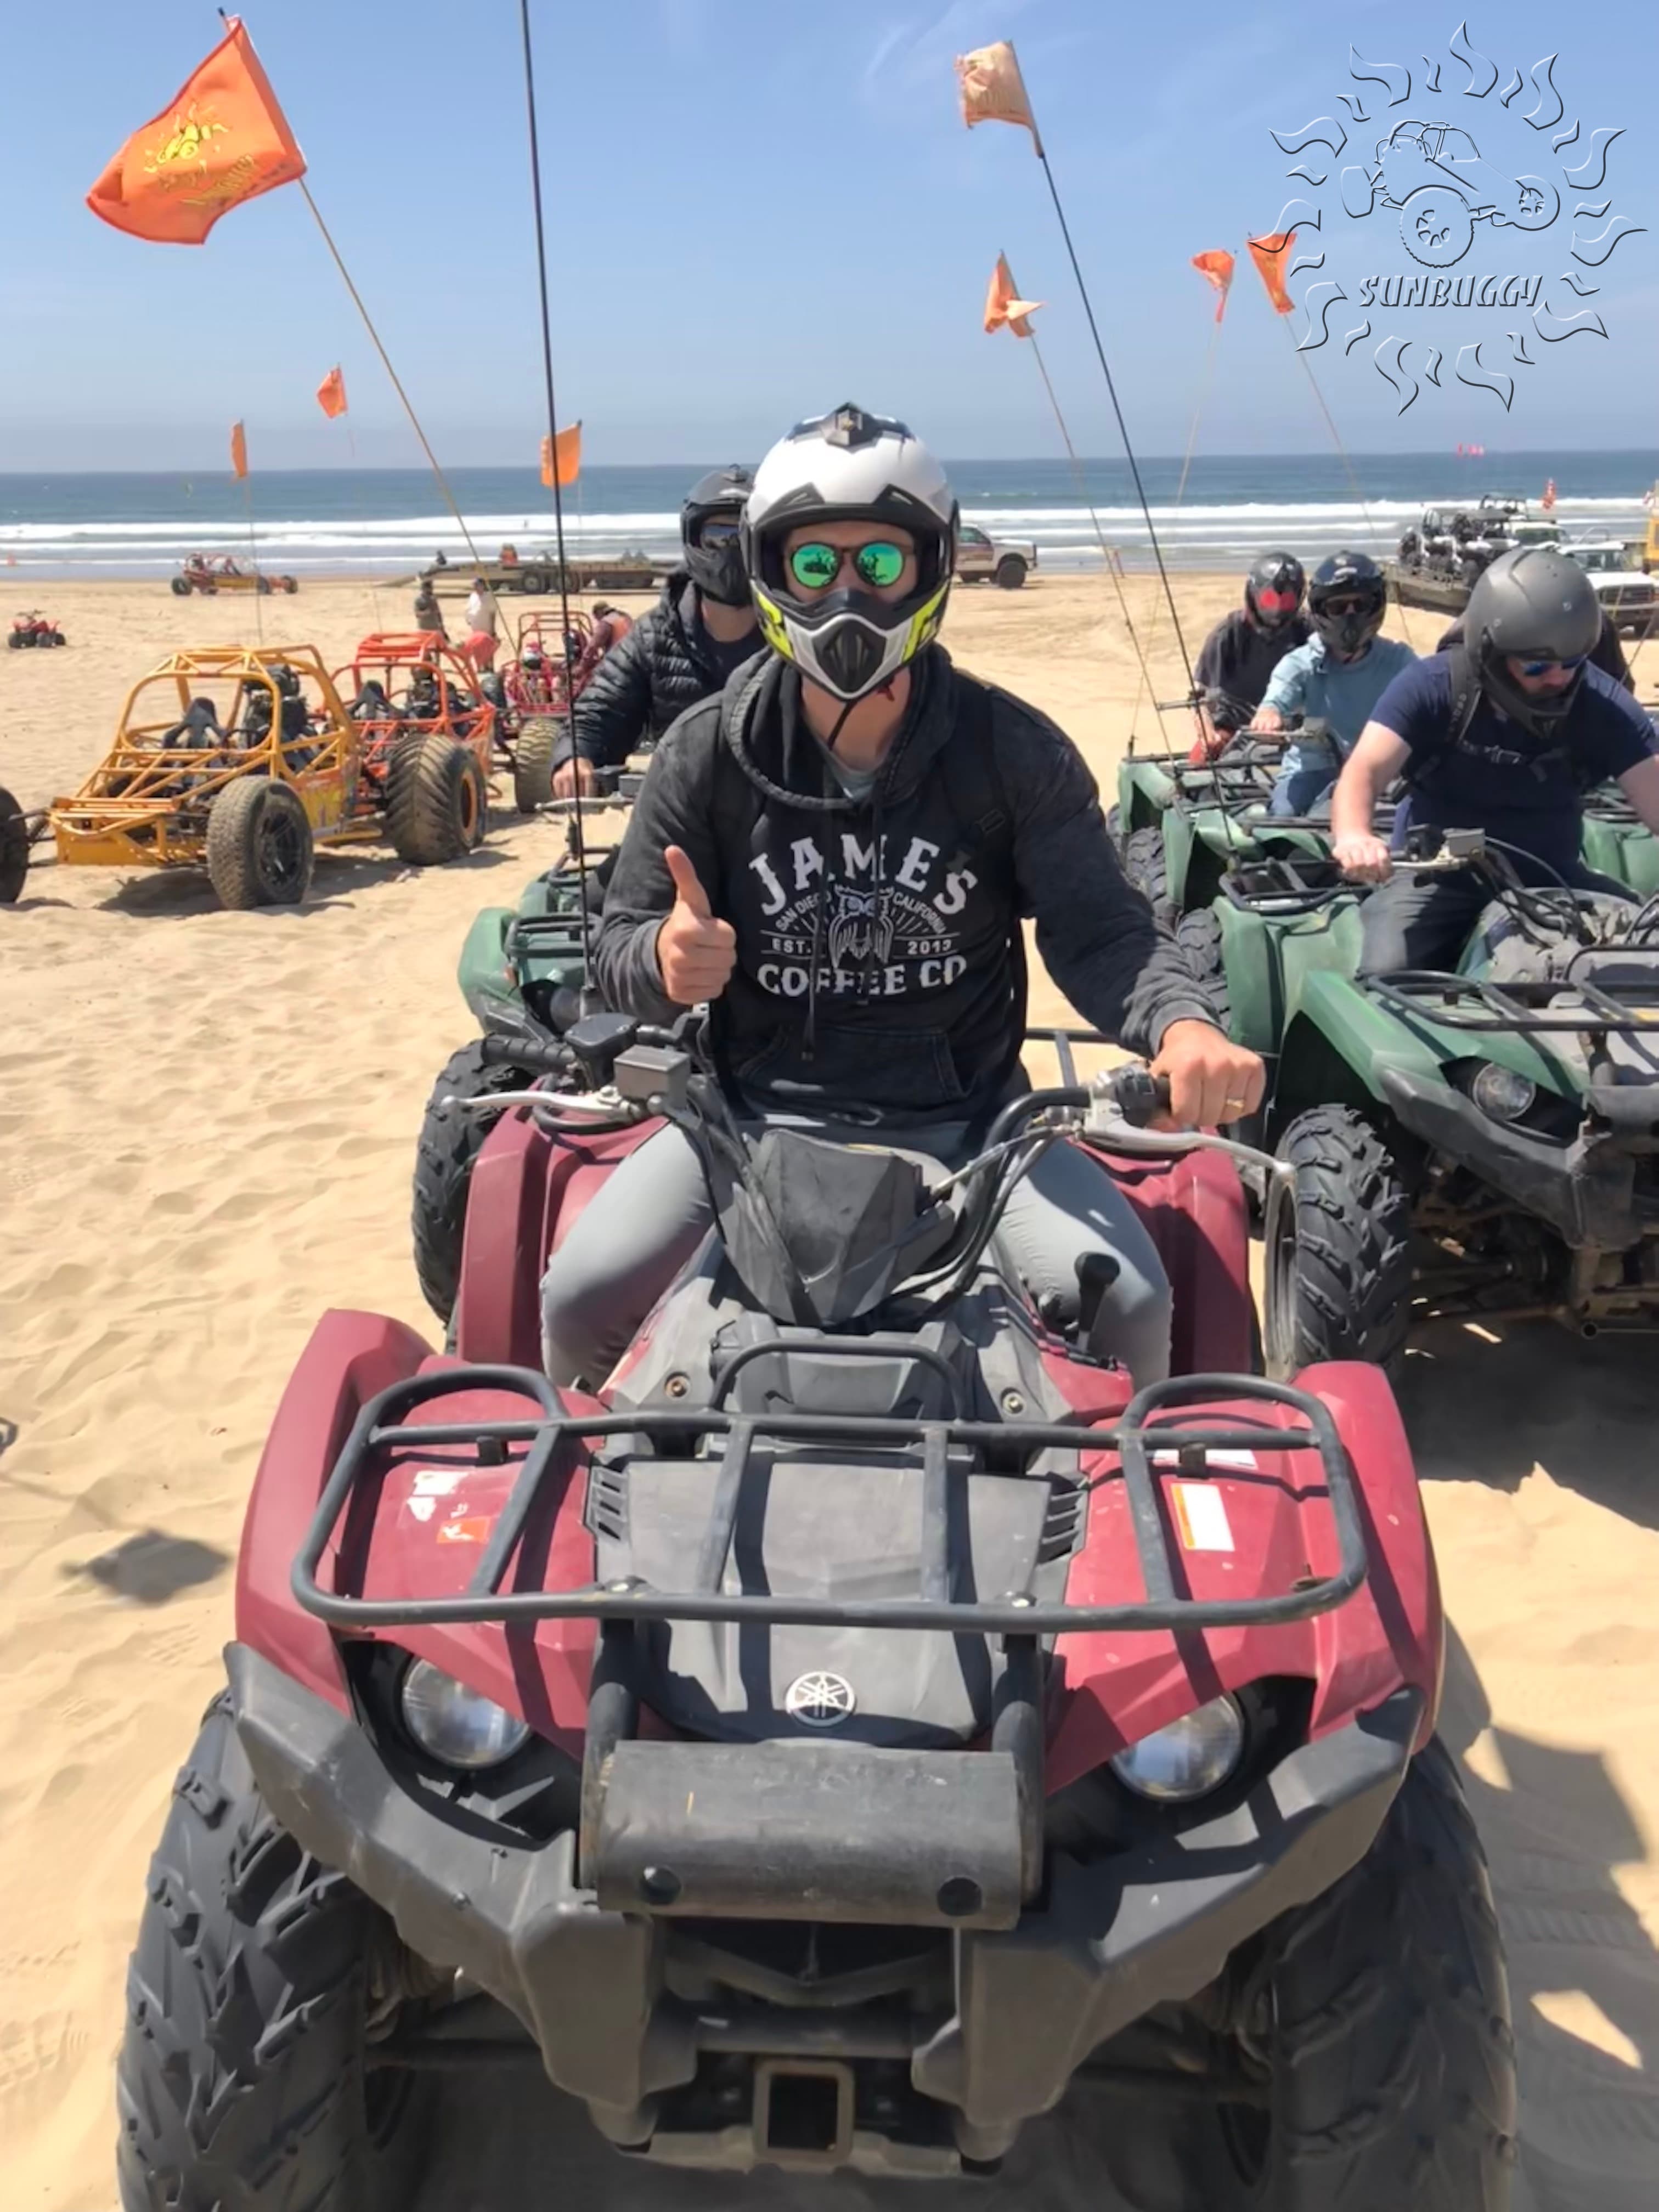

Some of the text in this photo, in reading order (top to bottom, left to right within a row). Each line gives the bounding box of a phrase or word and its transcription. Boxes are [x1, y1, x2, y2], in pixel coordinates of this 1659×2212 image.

[748, 834, 978, 915] JAMES
[775, 907, 798, 931] SAN
[772, 938, 812, 953] EST.
[757, 963, 907, 997] COFFEE
